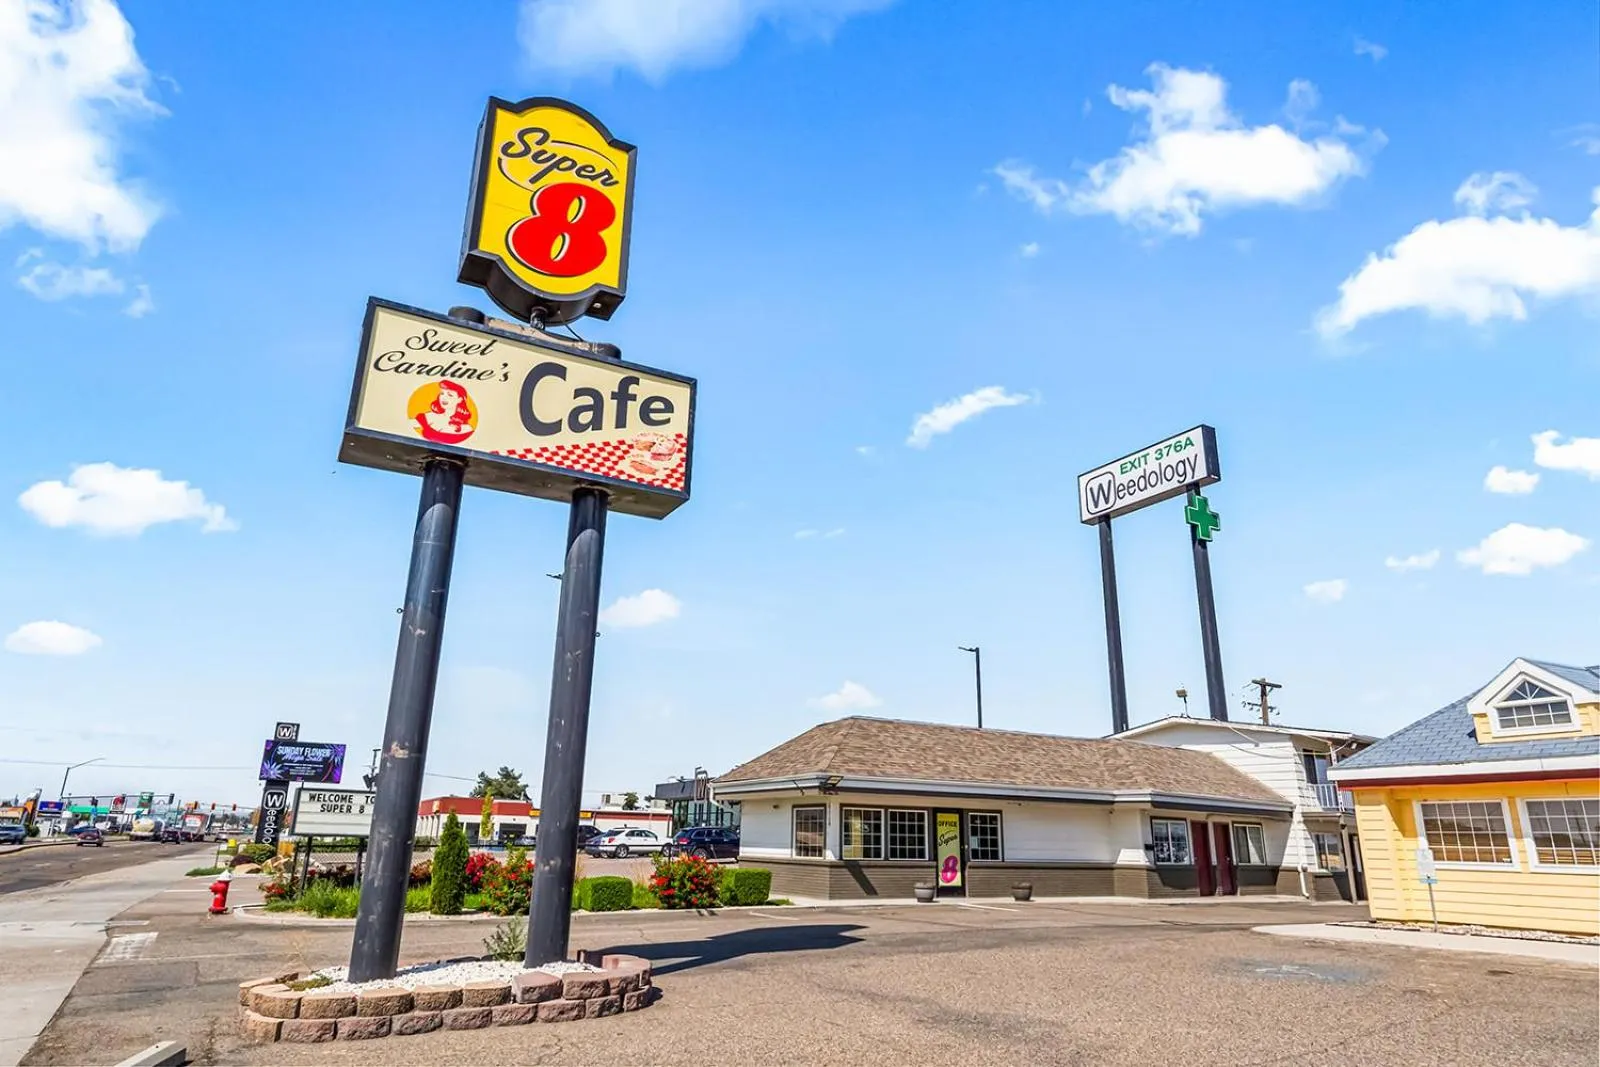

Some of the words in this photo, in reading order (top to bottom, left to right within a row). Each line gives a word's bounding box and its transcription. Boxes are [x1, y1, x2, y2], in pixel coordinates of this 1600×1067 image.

[500, 127, 620, 188] Super
[505, 182, 616, 278] 8
[405, 328, 498, 357] Sweet
[373, 350, 510, 383] Caroline's
[518, 361, 675, 437] Cafe
[1119, 453, 1150, 476] EXIT
[1154, 436, 1195, 461] 376A
[1088, 453, 1198, 511] Weedology
[276, 746, 305, 756] SUNDAY
[304, 747, 331, 757] FLOWER
[308, 793, 354, 804] WELCOME
[320, 804, 352, 813] SUPER
[358, 805, 365, 814] 8
